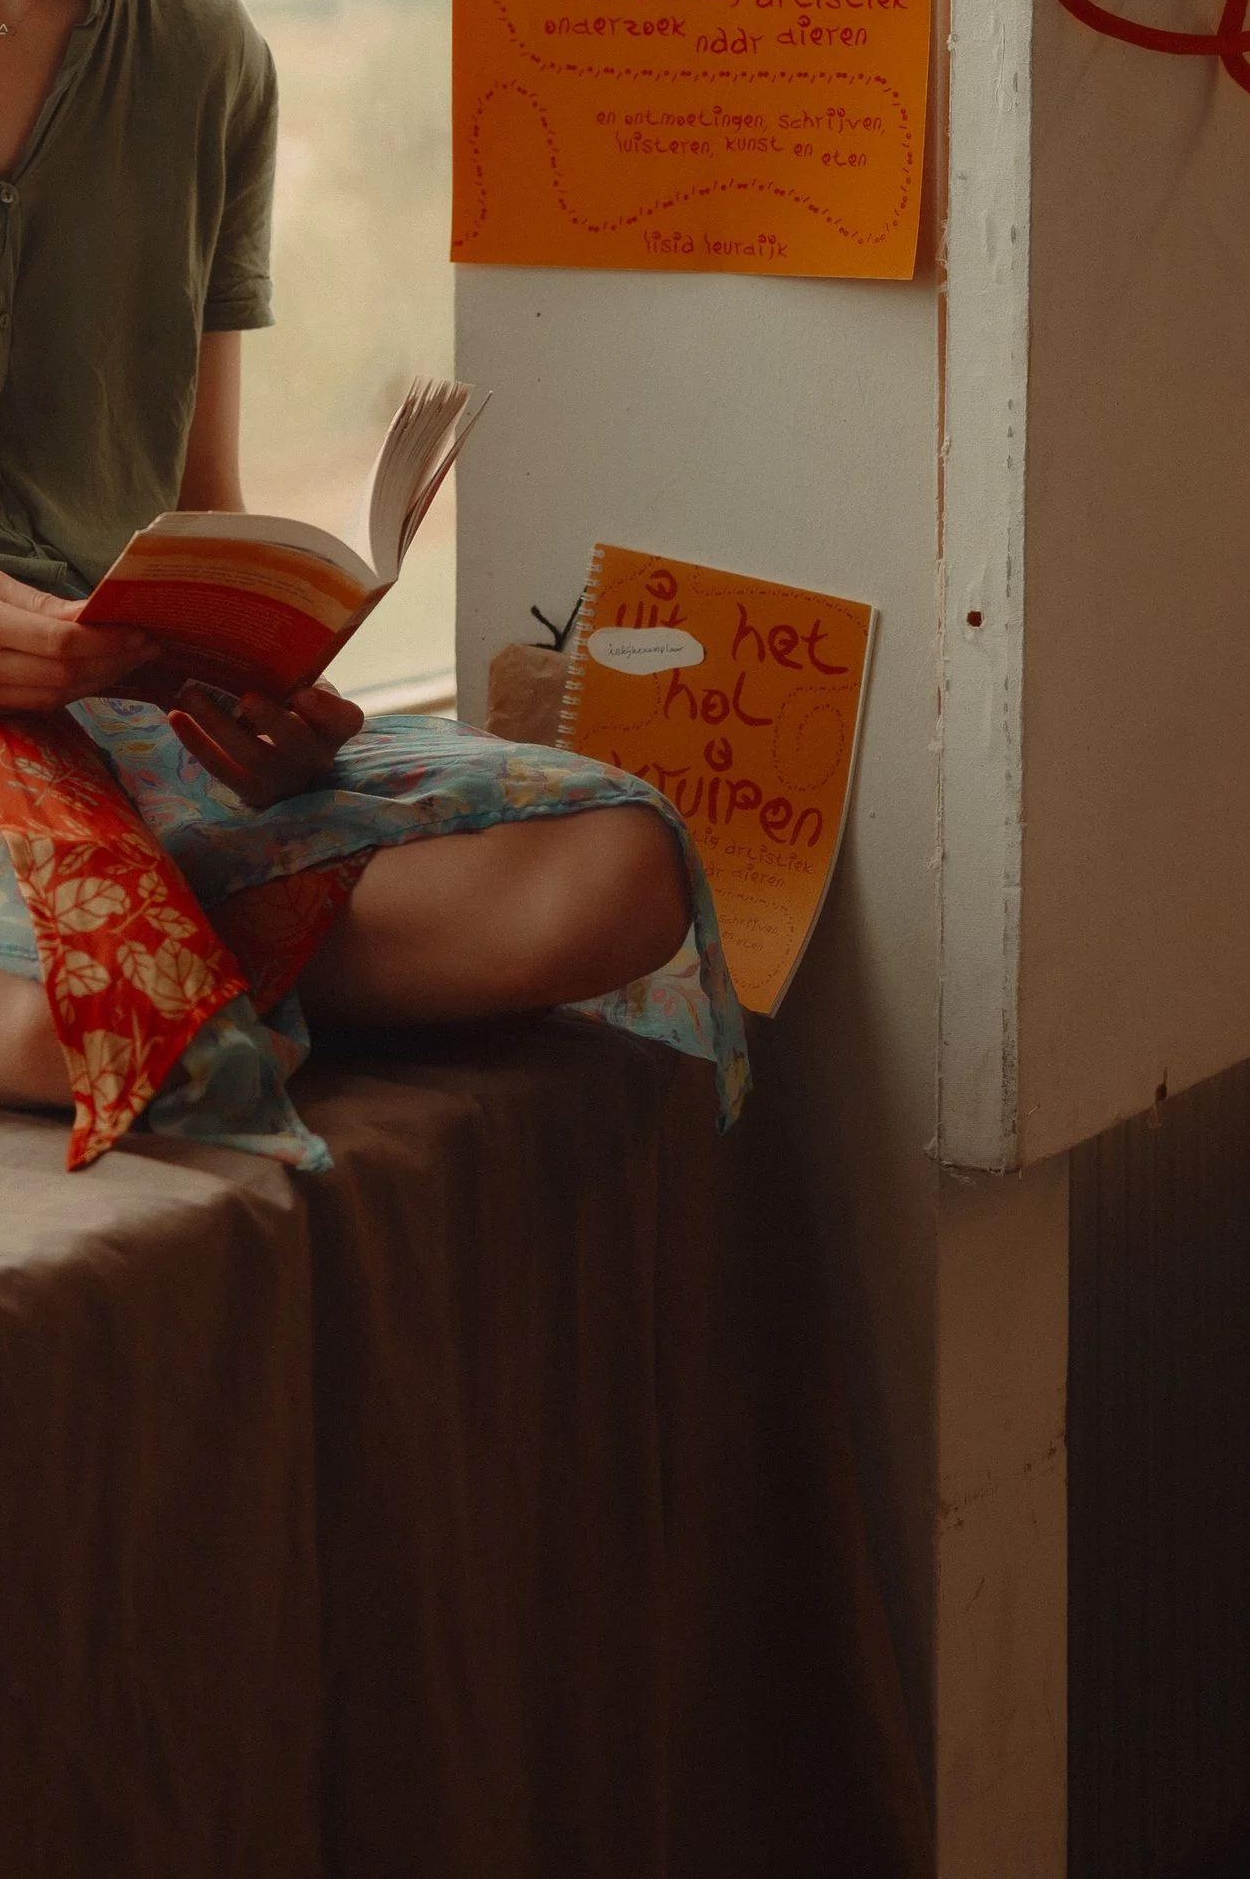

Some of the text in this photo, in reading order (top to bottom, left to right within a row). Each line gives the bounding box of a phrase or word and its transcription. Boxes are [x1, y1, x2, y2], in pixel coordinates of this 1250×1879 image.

[596, 110, 616, 126] en
[726, 135, 785, 152] kunst
[793, 141, 814, 158] en
[821, 150, 867, 167] eten
[731, 601, 849, 675] het
